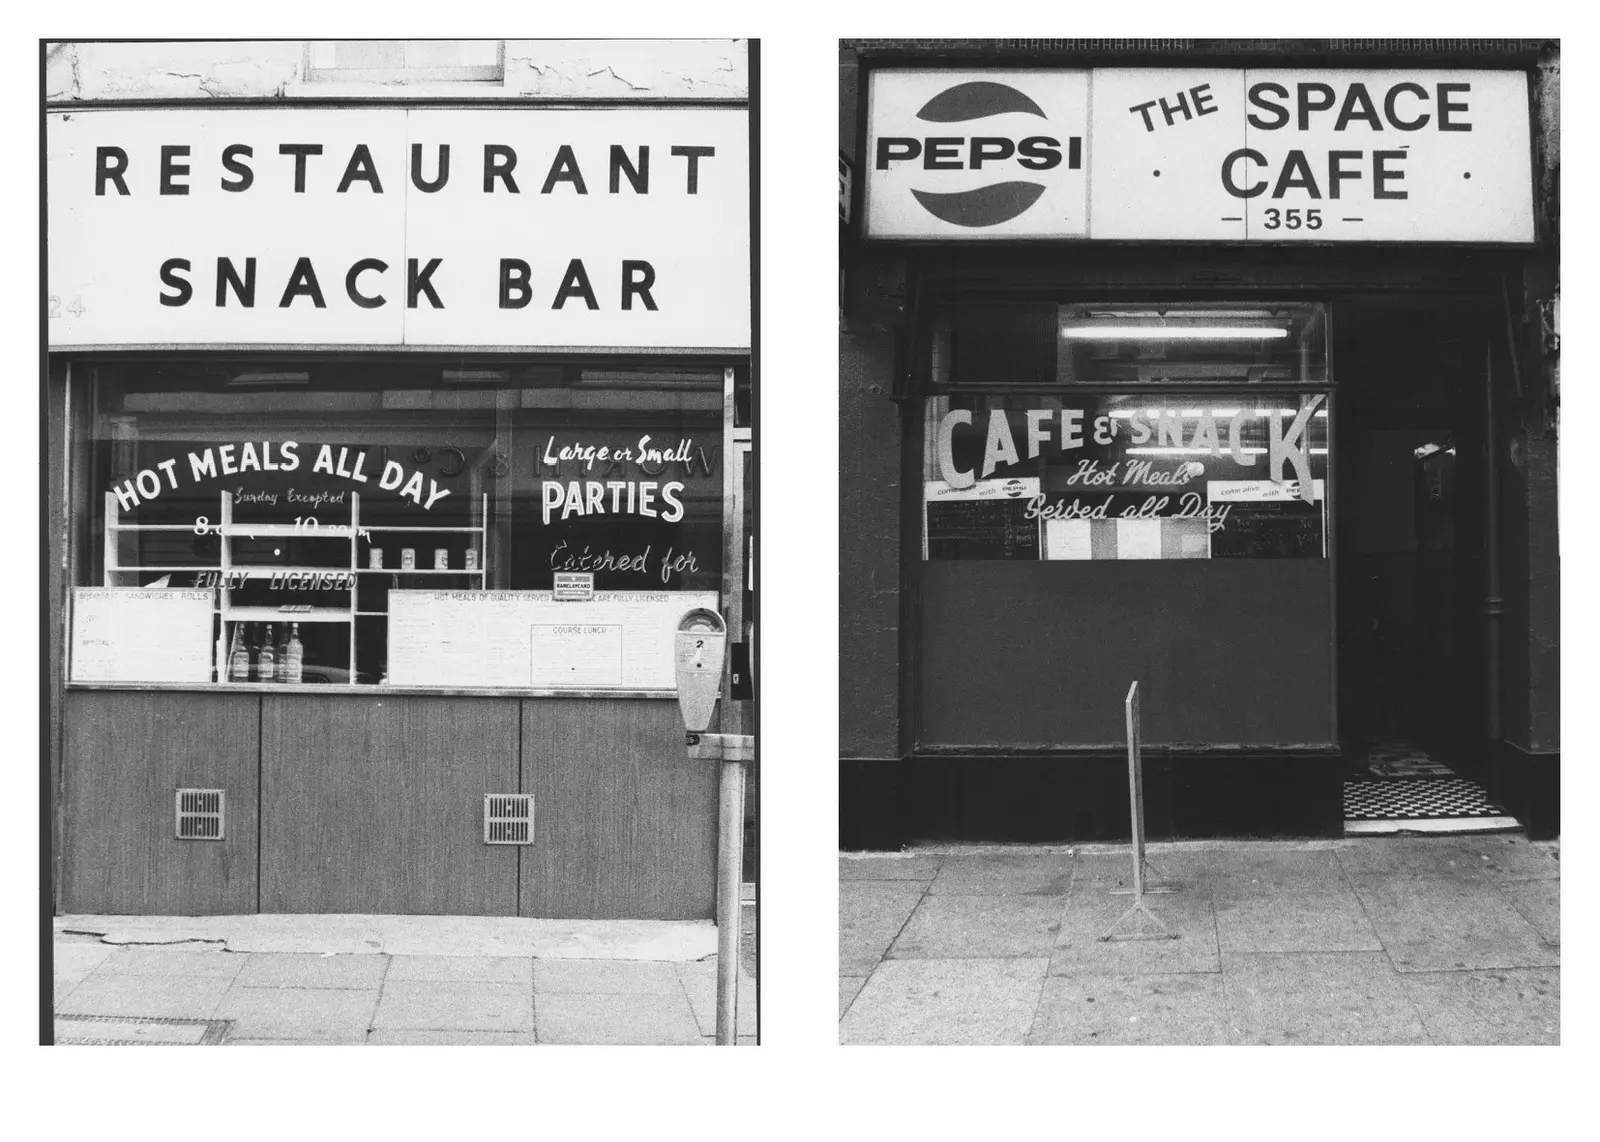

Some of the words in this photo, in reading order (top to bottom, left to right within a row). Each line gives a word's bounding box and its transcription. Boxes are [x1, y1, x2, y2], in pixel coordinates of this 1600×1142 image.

[1129, 84, 1219, 133] THE
[1246, 81, 1473, 133] SPACE
[94, 143, 715, 196] RESTAURANT
[875, 136, 1082, 170] PEPSI
[1220, 145, 1410, 200] CAFÉ
[1263, 208, 1323, 231] 355
[159, 257, 445, 309] SNACK
[499, 258, 659, 311] BAR
[543, 435, 609, 470] Large
[614, 447, 632, 461] or
[635, 434, 692, 465] Small
[938, 409, 1084, 489] CAFE
[1093, 416, 1118, 446] &
[1130, 394, 1326, 506] SNACK
[112, 459, 177, 512] HOT
[188, 441, 300, 482] MEALS
[313, 444, 367, 483] ALL
[379, 460, 451, 511] DAY
[1067, 459, 1115, 486] Hot
[1124, 459, 1192, 486] Meals
[234, 486, 278, 505] Sunday
[542, 481, 685, 525] PARTIES
[1024, 492, 1107, 520] Served
[1120, 495, 1162, 519] all
[1170, 492, 1232, 534] Day
[195, 571, 249, 590] FULLY
[269, 571, 358, 591] LICENSED
[550, 539, 651, 574] Catered
[661, 547, 699, 583] for
[181, 592, 209, 601] ROLLS
